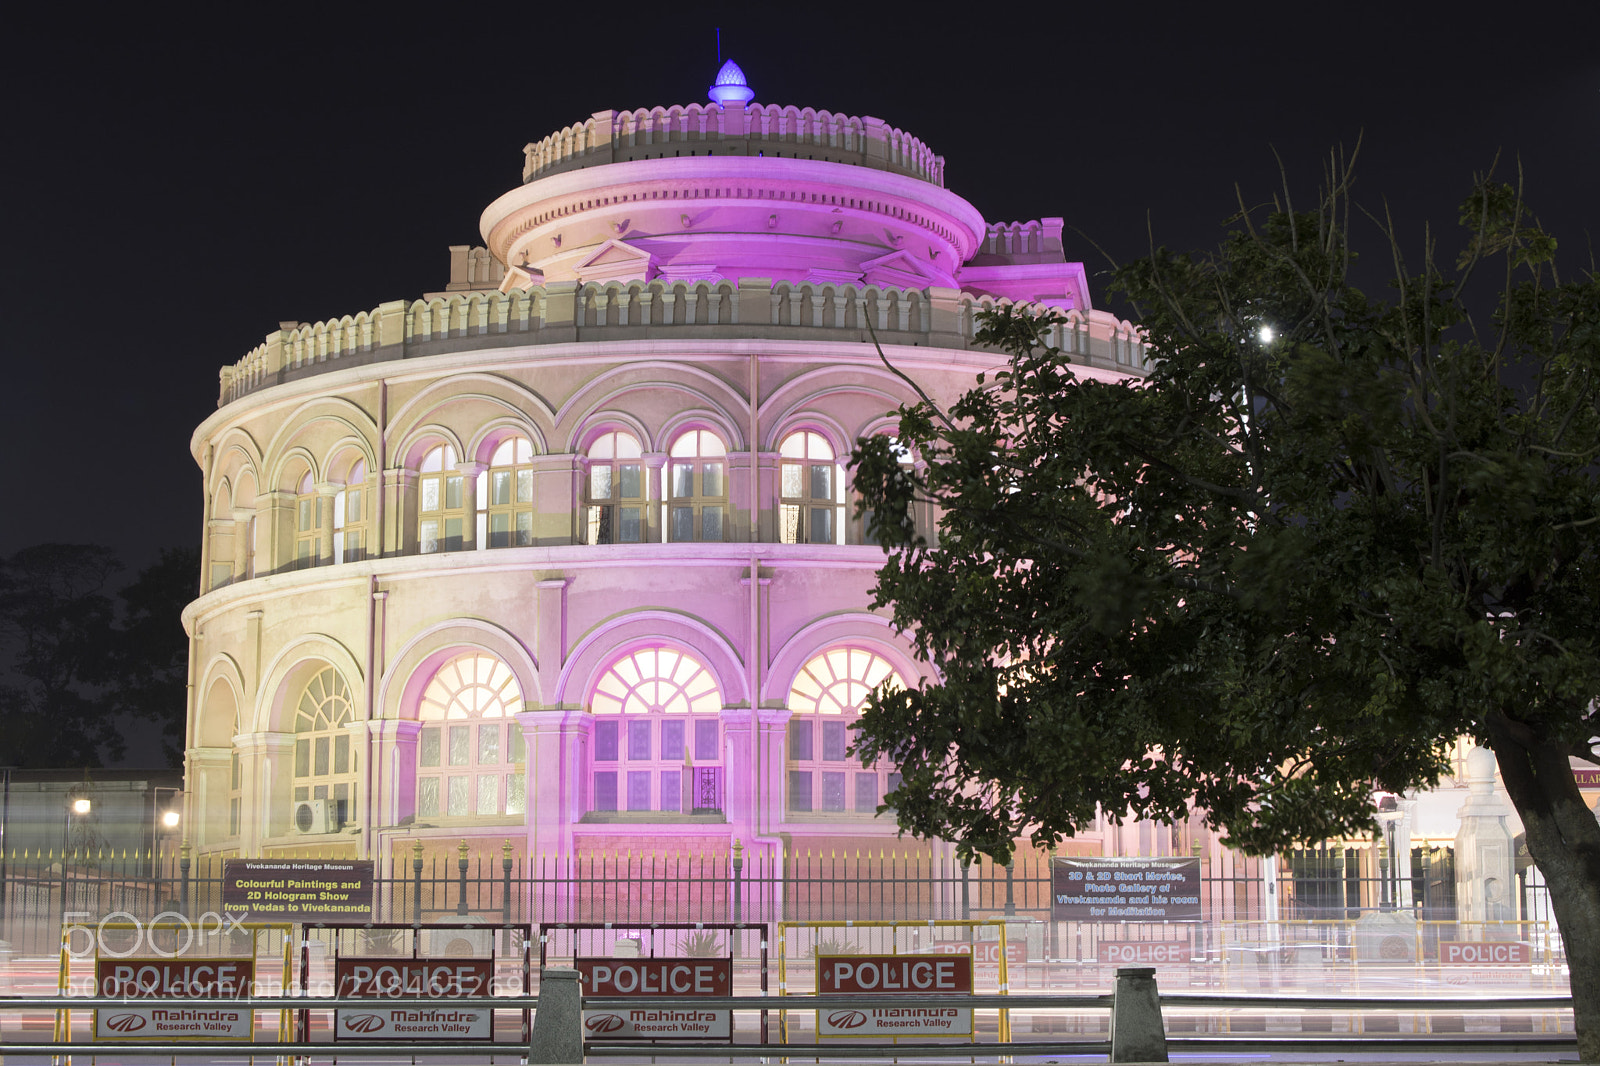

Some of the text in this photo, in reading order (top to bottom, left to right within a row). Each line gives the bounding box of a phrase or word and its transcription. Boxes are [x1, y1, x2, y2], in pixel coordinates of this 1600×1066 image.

[292, 863, 323, 871] Heritage
[1120, 861, 1150, 869] Heritage
[1068, 871, 1186, 882] 3D & 2D Short Movies,
[235, 879, 361, 891] Colourful Paintings and
[1084, 883, 1171, 895] Photo Gallery of
[247, 891, 349, 902] 2D Hologram Show
[1056, 894, 1199, 904] Vivekananda and his room
[224, 903, 371, 913] from Vedas to Vivekananda
[1089, 906, 1166, 916] for Meditation
[1107, 945, 1180, 962] POLICE
[1448, 945, 1521, 962] POLICE
[114, 965, 237, 993] POLICE
[353, 965, 476, 993] POLICE
[592, 965, 714, 993] POLICE
[834, 961, 956, 989] POLICE
[151, 1009, 240, 1021] Mahindra
[390, 1010, 478, 1022] Mahindra
[629, 1010, 717, 1022] Mahindra
[156, 1022, 232, 1033] Research Valley
[394, 1023, 471, 1034] Research Valley
[633, 1023, 710, 1033] Research Valley
[876, 1019, 952, 1028] Research Valley
